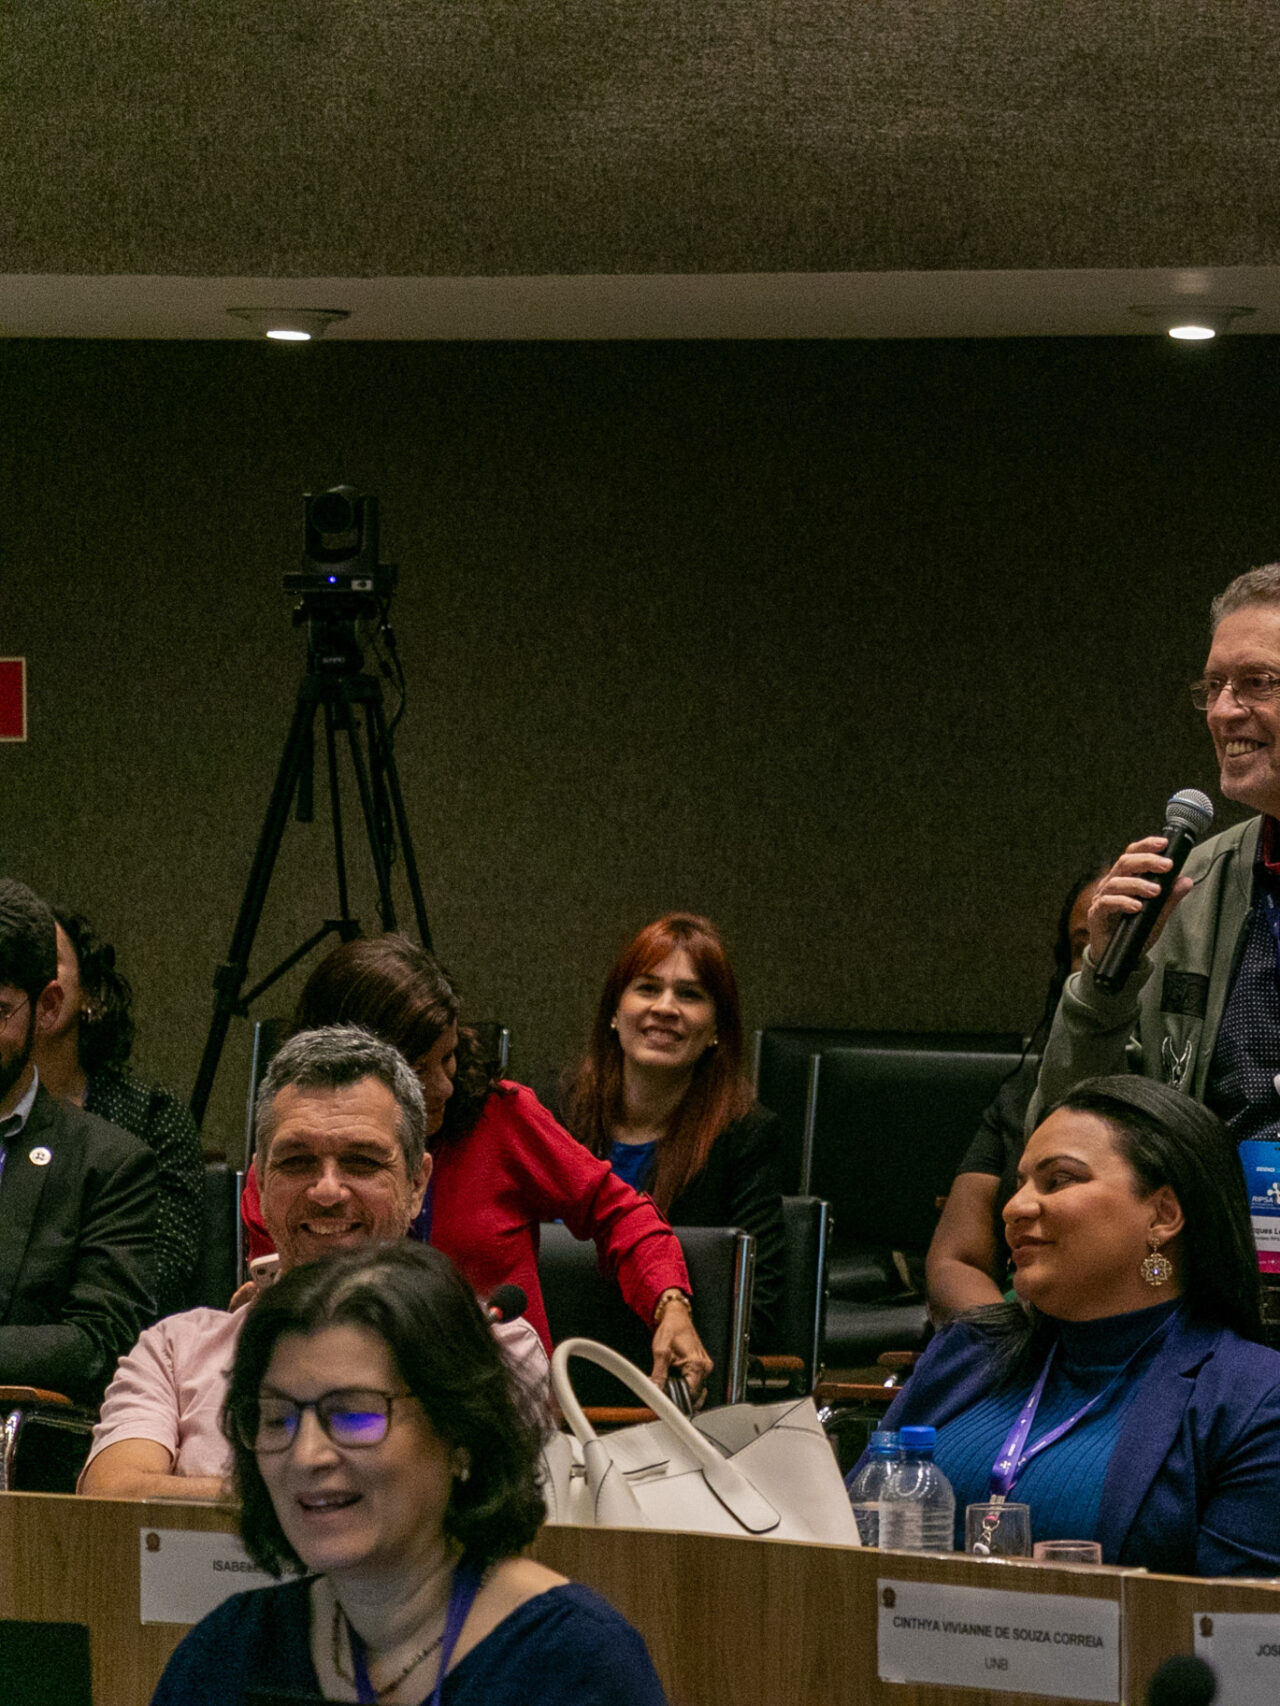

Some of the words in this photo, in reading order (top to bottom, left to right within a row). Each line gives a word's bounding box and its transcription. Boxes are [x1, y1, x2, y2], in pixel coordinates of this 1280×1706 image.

[893, 1616, 940, 1631] CINTHYA
[942, 1621, 992, 1638] VIVIANNE
[995, 1626, 1010, 1640] DE
[1012, 1628, 1051, 1644] SOUZA
[1053, 1632, 1104, 1649] CORREIA
[984, 1657, 1009, 1671] UNB
